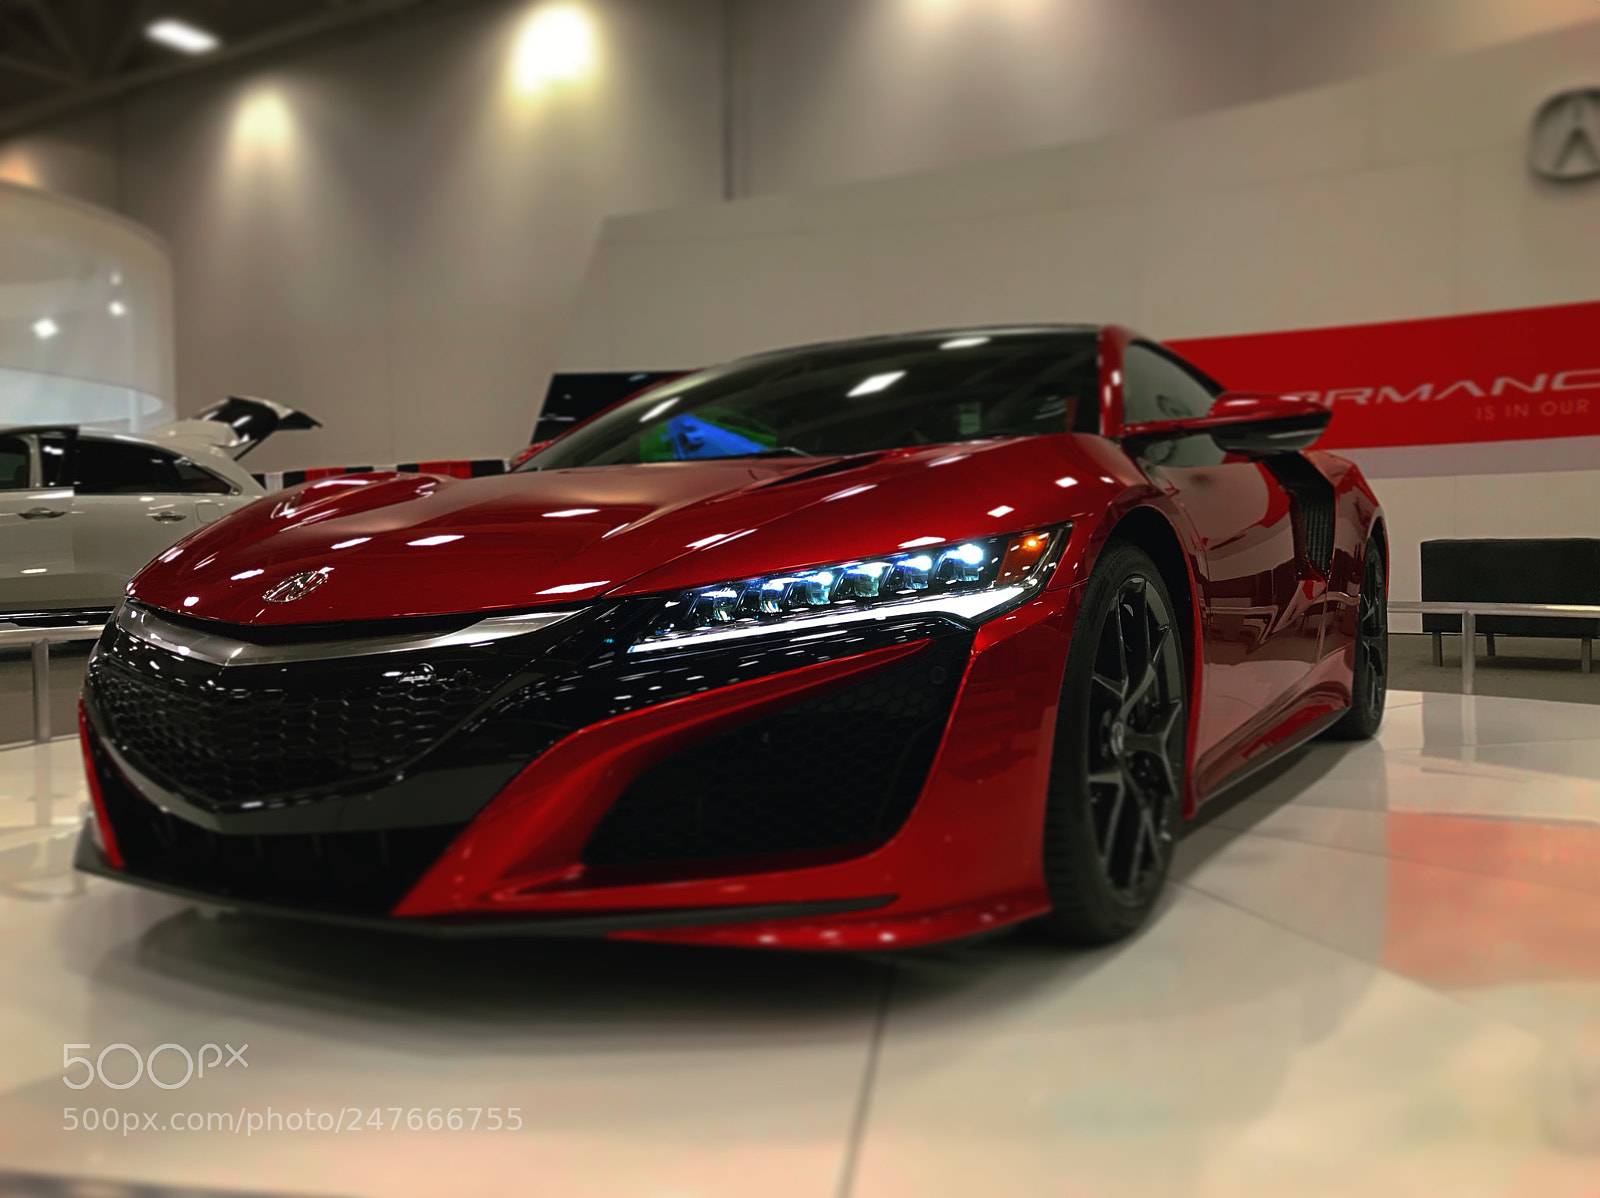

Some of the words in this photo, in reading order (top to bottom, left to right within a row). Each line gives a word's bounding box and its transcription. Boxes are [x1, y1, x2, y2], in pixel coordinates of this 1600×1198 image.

[1475, 404, 1496, 421] IS
[1504, 402, 1530, 419] IN
[1540, 398, 1590, 417] OUR
